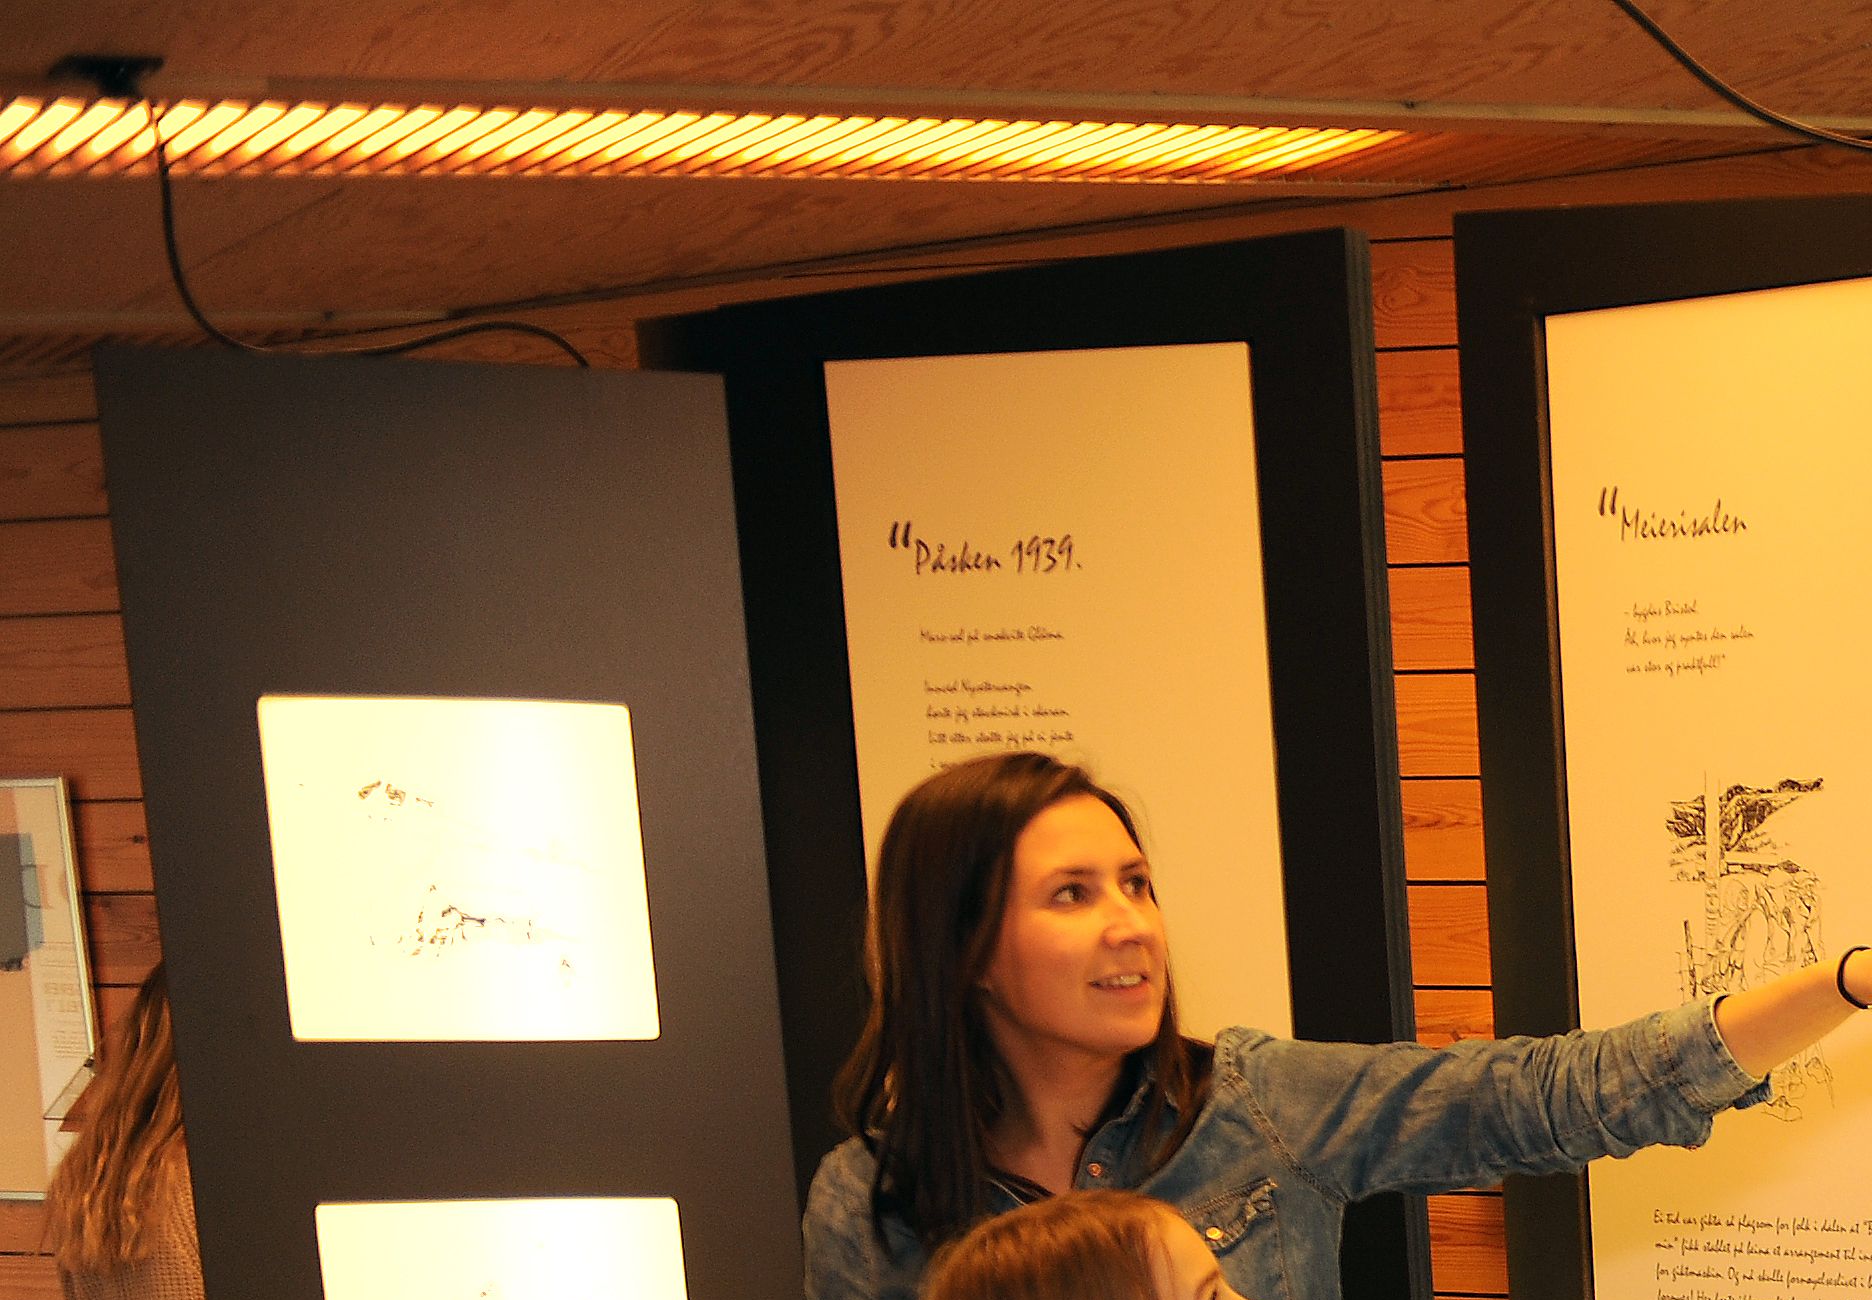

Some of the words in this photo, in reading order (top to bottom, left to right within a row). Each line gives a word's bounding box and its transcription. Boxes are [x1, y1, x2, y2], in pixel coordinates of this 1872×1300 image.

[1011, 534, 1083, 575] 1939.
[1776, 1217, 1789, 1236] for
[1657, 1262, 1669, 1281] for
[1728, 1266, 1741, 1286] Og
